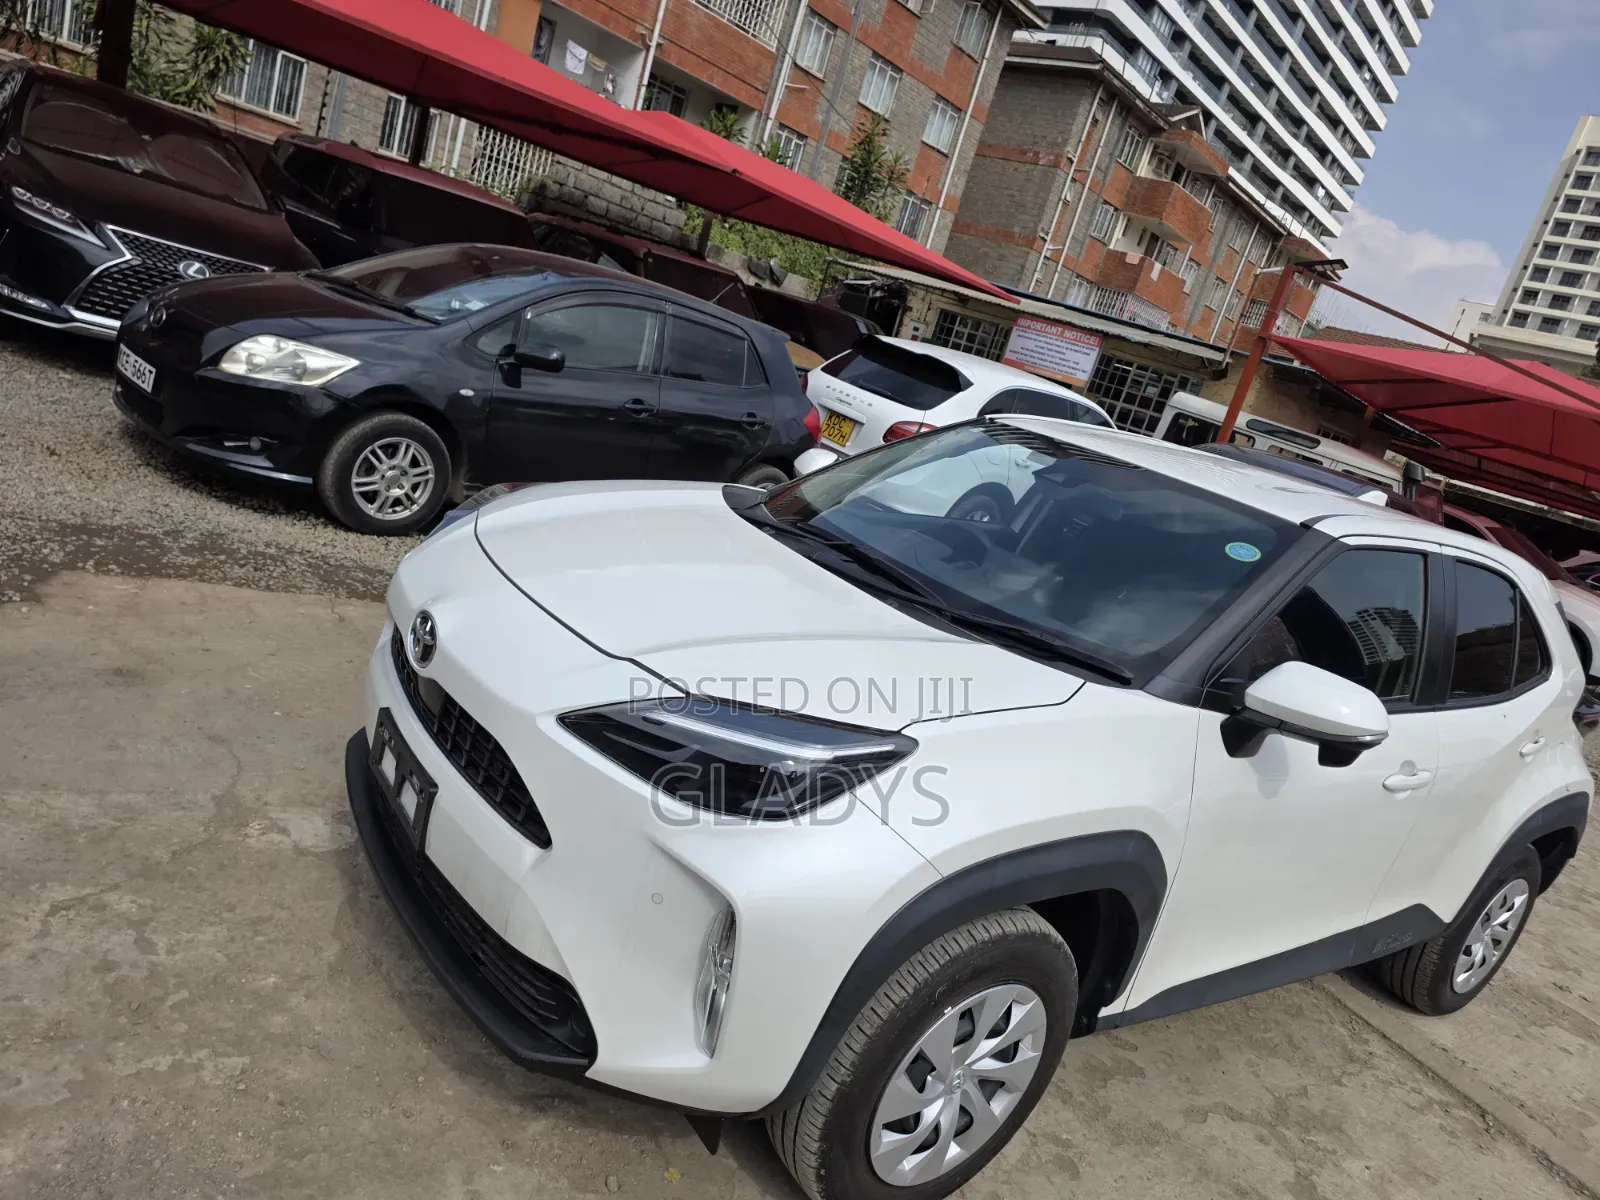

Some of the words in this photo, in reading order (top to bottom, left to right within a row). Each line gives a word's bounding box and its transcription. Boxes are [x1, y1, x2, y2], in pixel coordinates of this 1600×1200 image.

[1017, 318, 1063, 335] IMPORTANT
[131, 359, 154, 389] 566T
[826, 411, 846, 429] KDC
[822, 423, 848, 443] 707H
